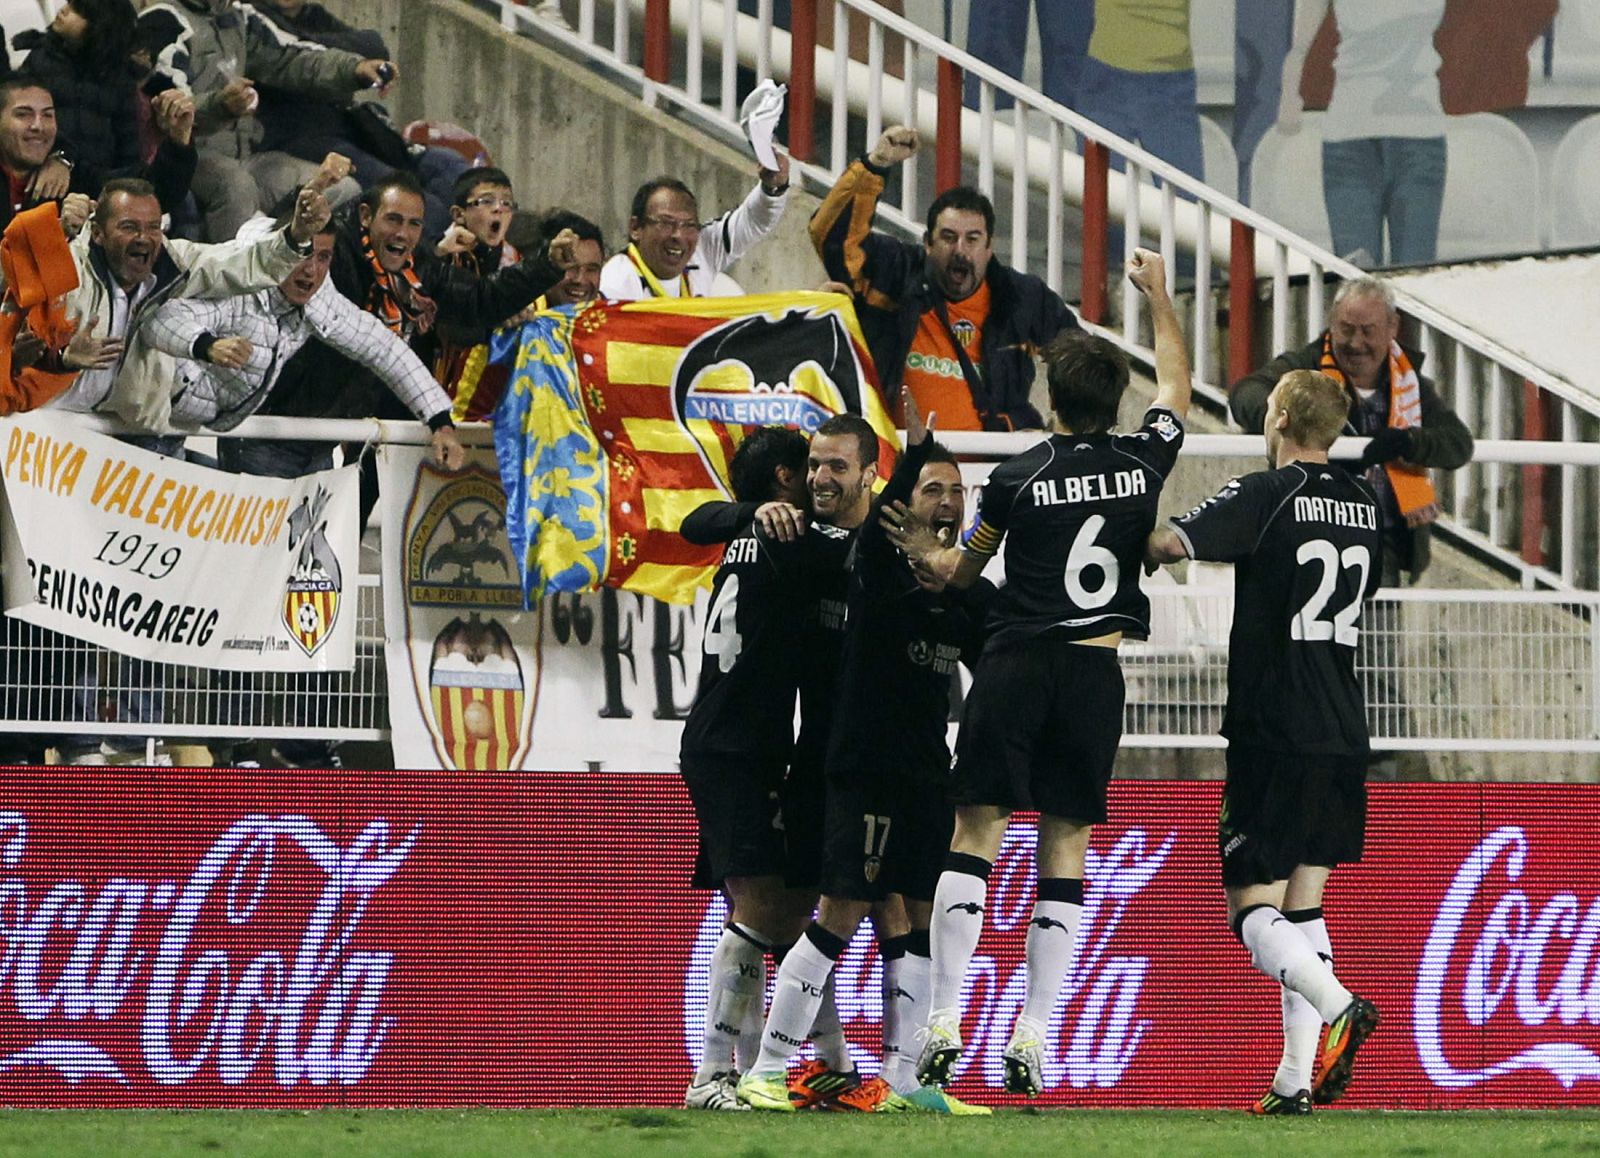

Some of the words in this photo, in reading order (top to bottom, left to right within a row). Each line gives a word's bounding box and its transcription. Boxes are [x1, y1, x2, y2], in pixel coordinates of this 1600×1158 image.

[691, 400, 801, 422] VALENCIA
[5, 426, 88, 497] PENYA
[1032, 468, 1146, 506] ALBELDA
[1294, 495, 1377, 531] MATHIEU
[93, 529, 182, 580] 1919
[720, 537, 758, 565] STA
[1064, 514, 1120, 610] 6
[1290, 538, 1370, 647] 22
[704, 573, 743, 673] 4
[863, 813, 892, 856] 17
